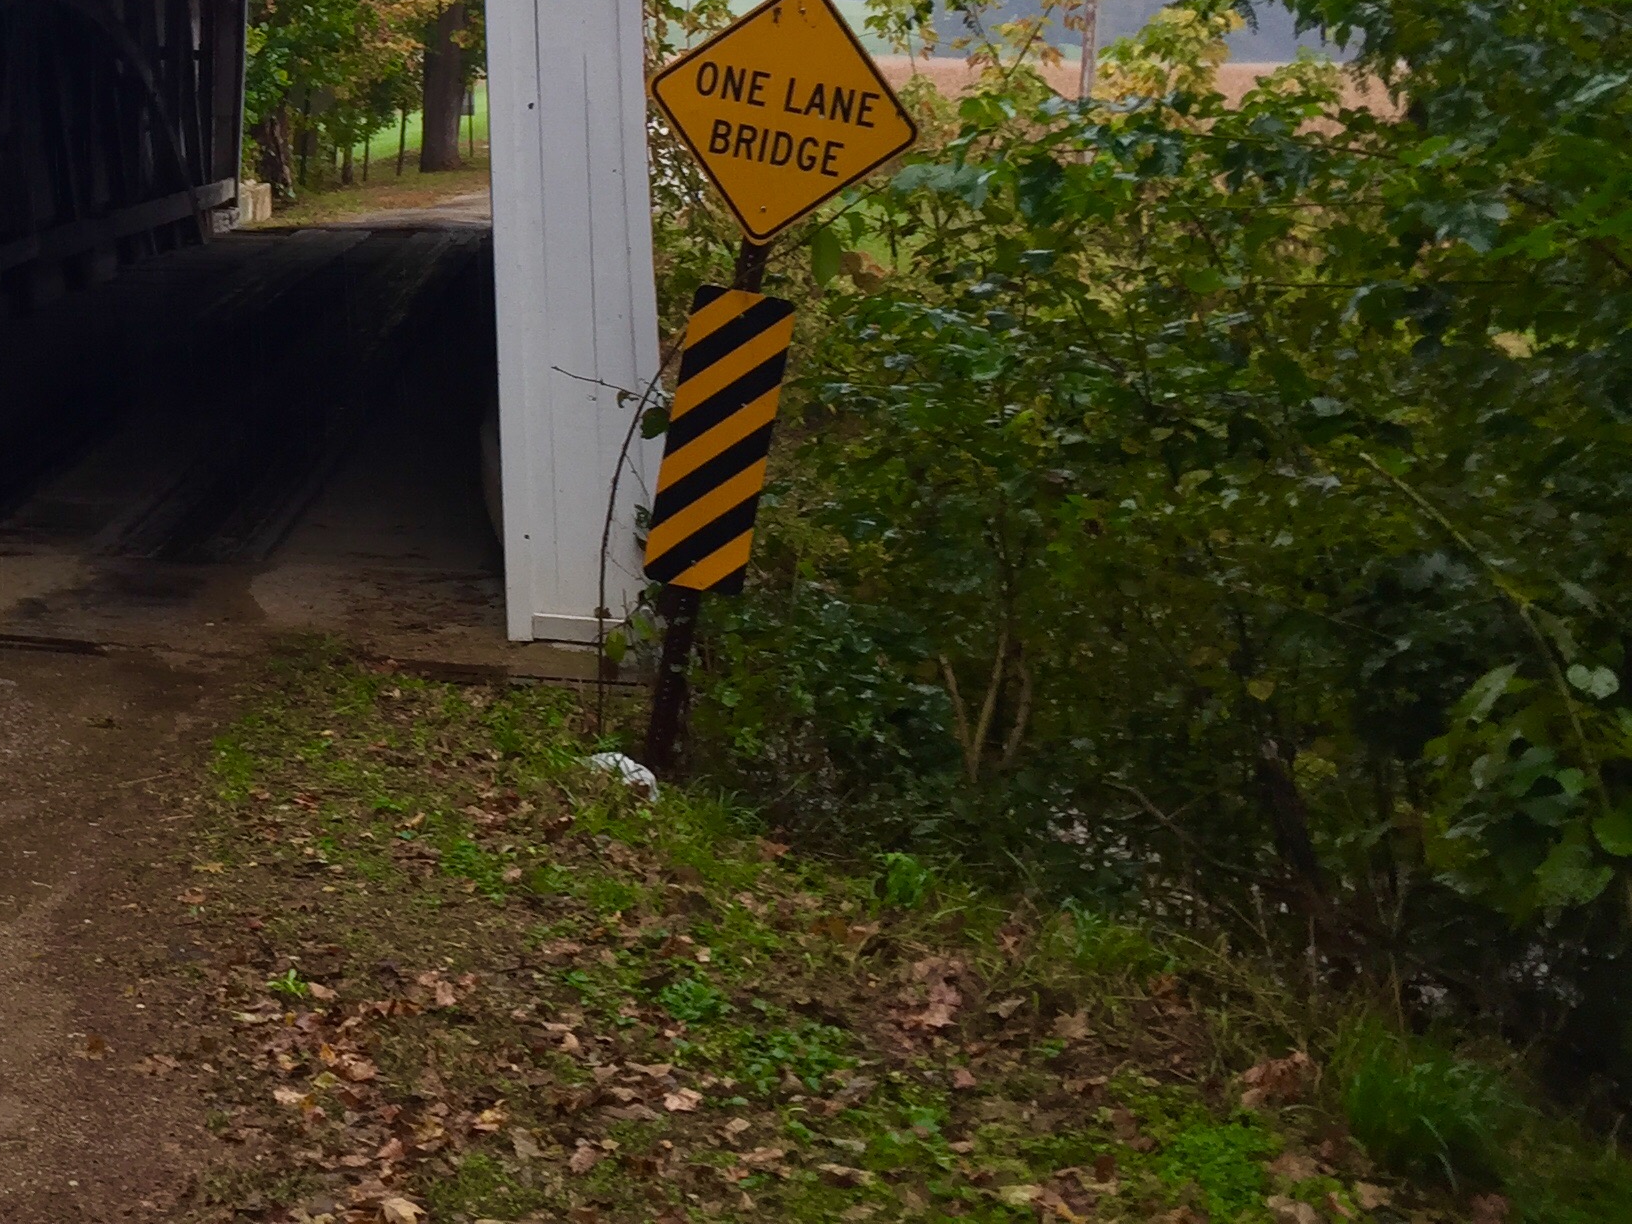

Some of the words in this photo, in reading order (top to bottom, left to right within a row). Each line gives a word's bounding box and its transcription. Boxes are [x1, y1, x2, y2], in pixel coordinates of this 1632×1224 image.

[695, 60, 772, 108] ONE
[783, 77, 880, 129] LANE
[707, 118, 845, 178] BRIDGE
